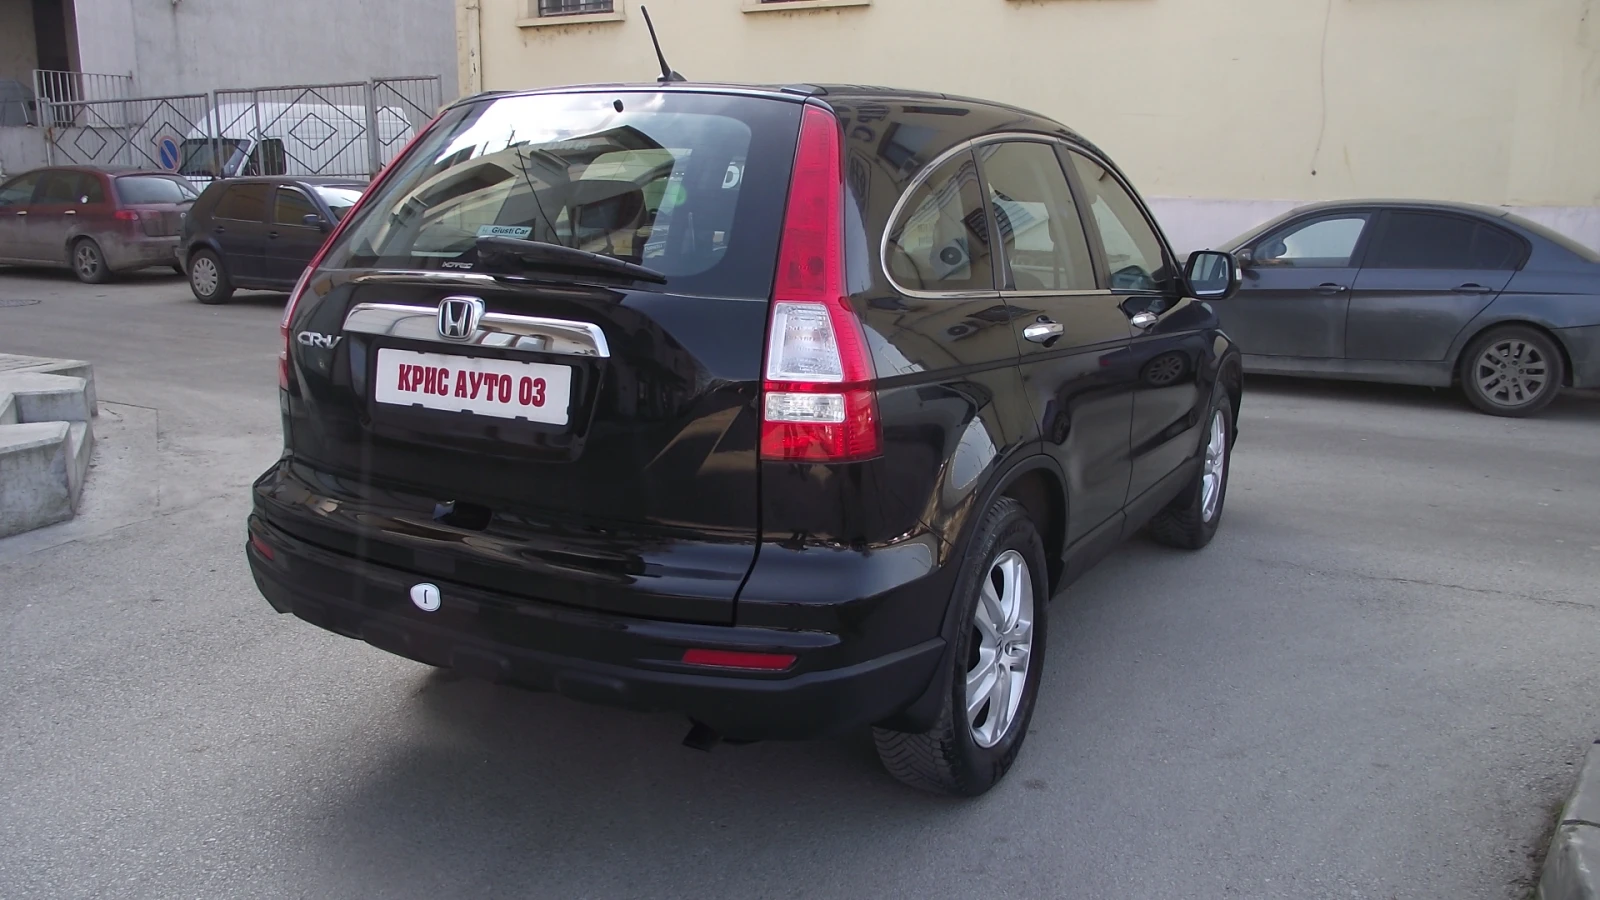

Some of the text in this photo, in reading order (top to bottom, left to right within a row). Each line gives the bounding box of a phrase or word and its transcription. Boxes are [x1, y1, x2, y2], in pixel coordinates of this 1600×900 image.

[491, 227, 514, 235] Giusti
[297, 331, 343, 349] CR-V
[398, 363, 449, 396] КРИС
[454, 370, 512, 403] АУТО
